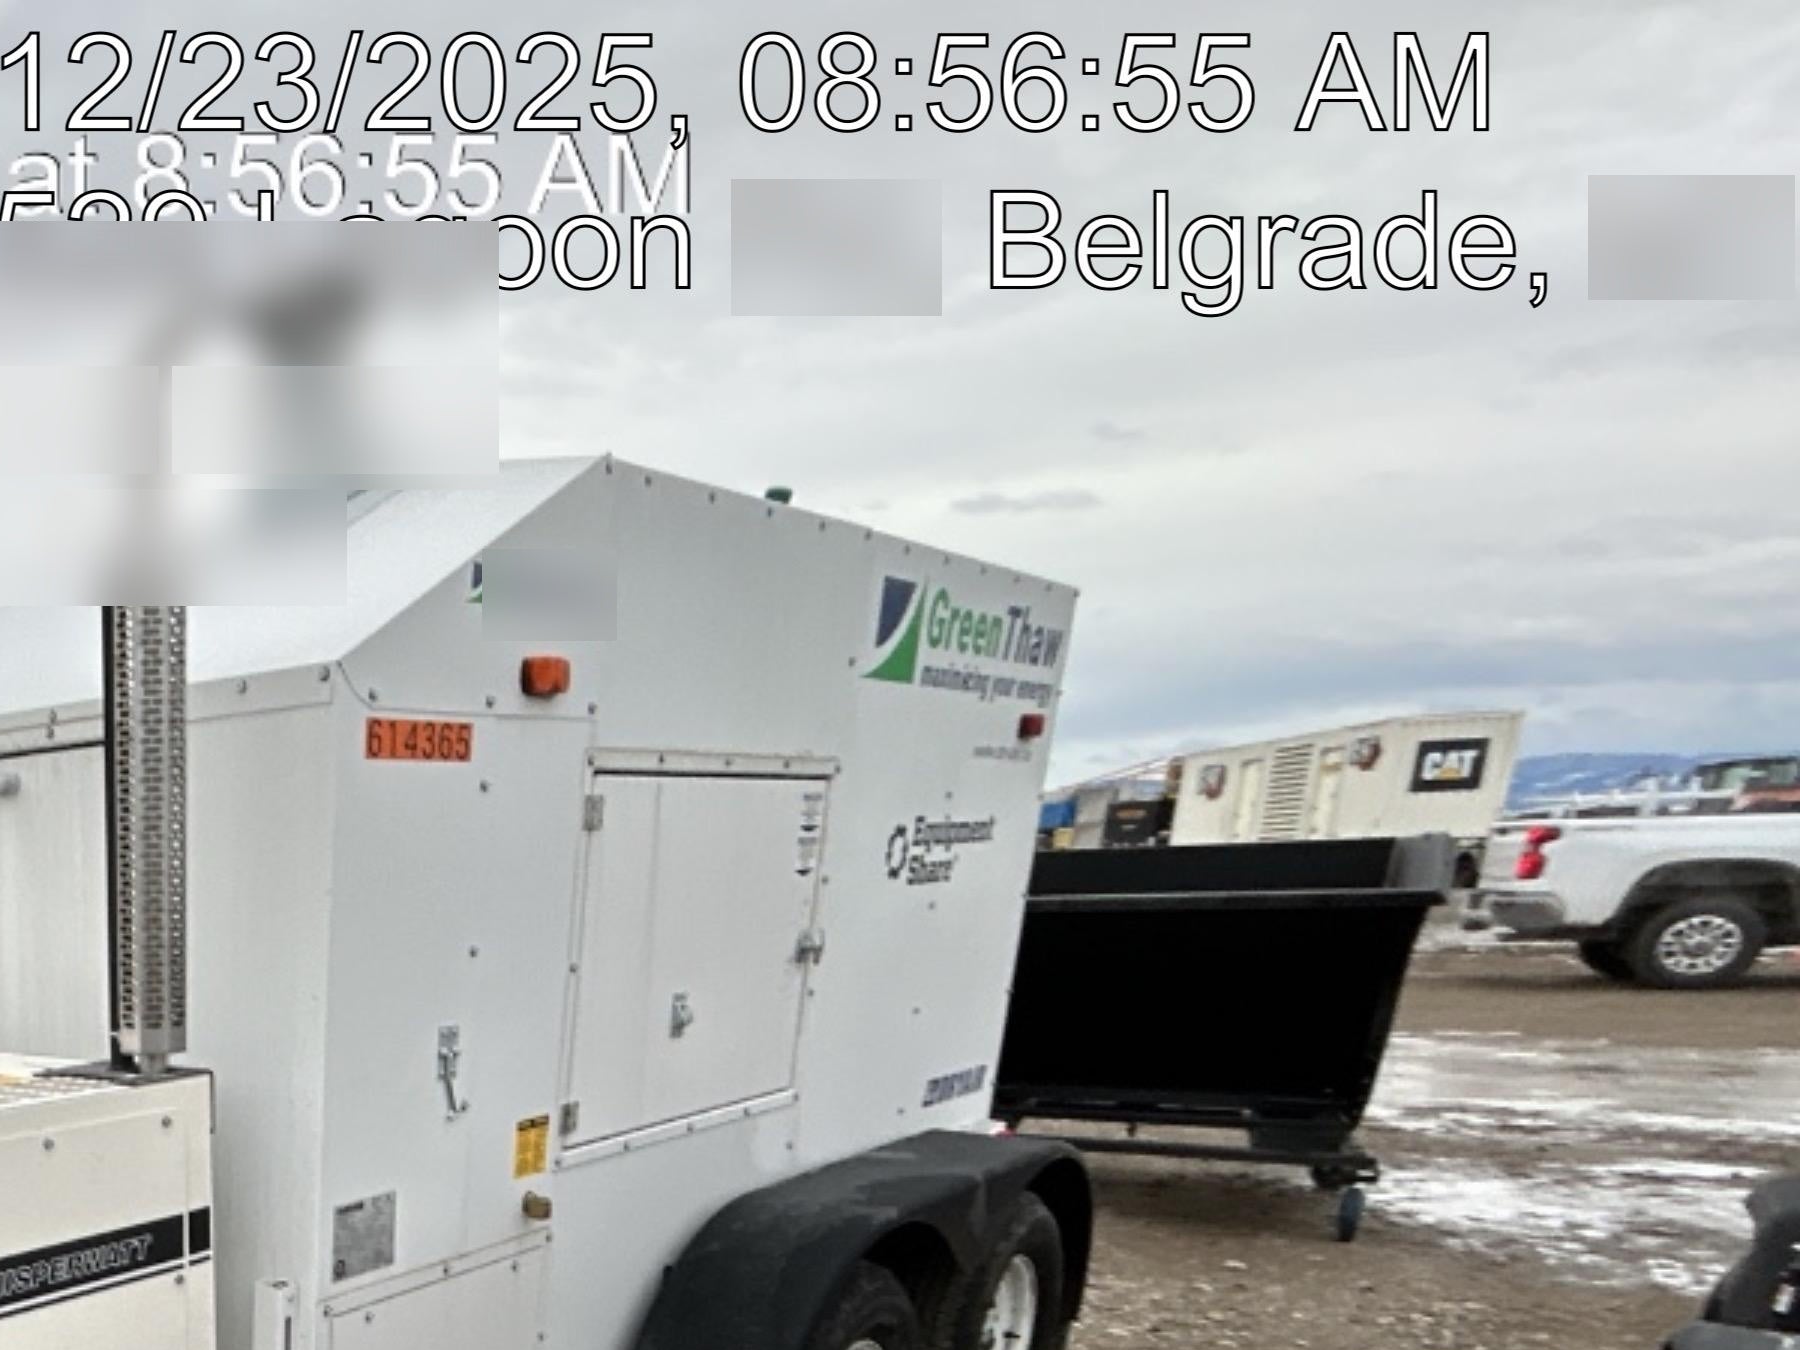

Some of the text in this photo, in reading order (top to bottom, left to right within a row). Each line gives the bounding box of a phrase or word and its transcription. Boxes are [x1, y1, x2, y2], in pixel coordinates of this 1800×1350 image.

[367, 718, 471, 761] 614365
[1421, 750, 1477, 781] CAT
[912, 814, 995, 852] Equipment
[907, 855, 952, 885] Share
